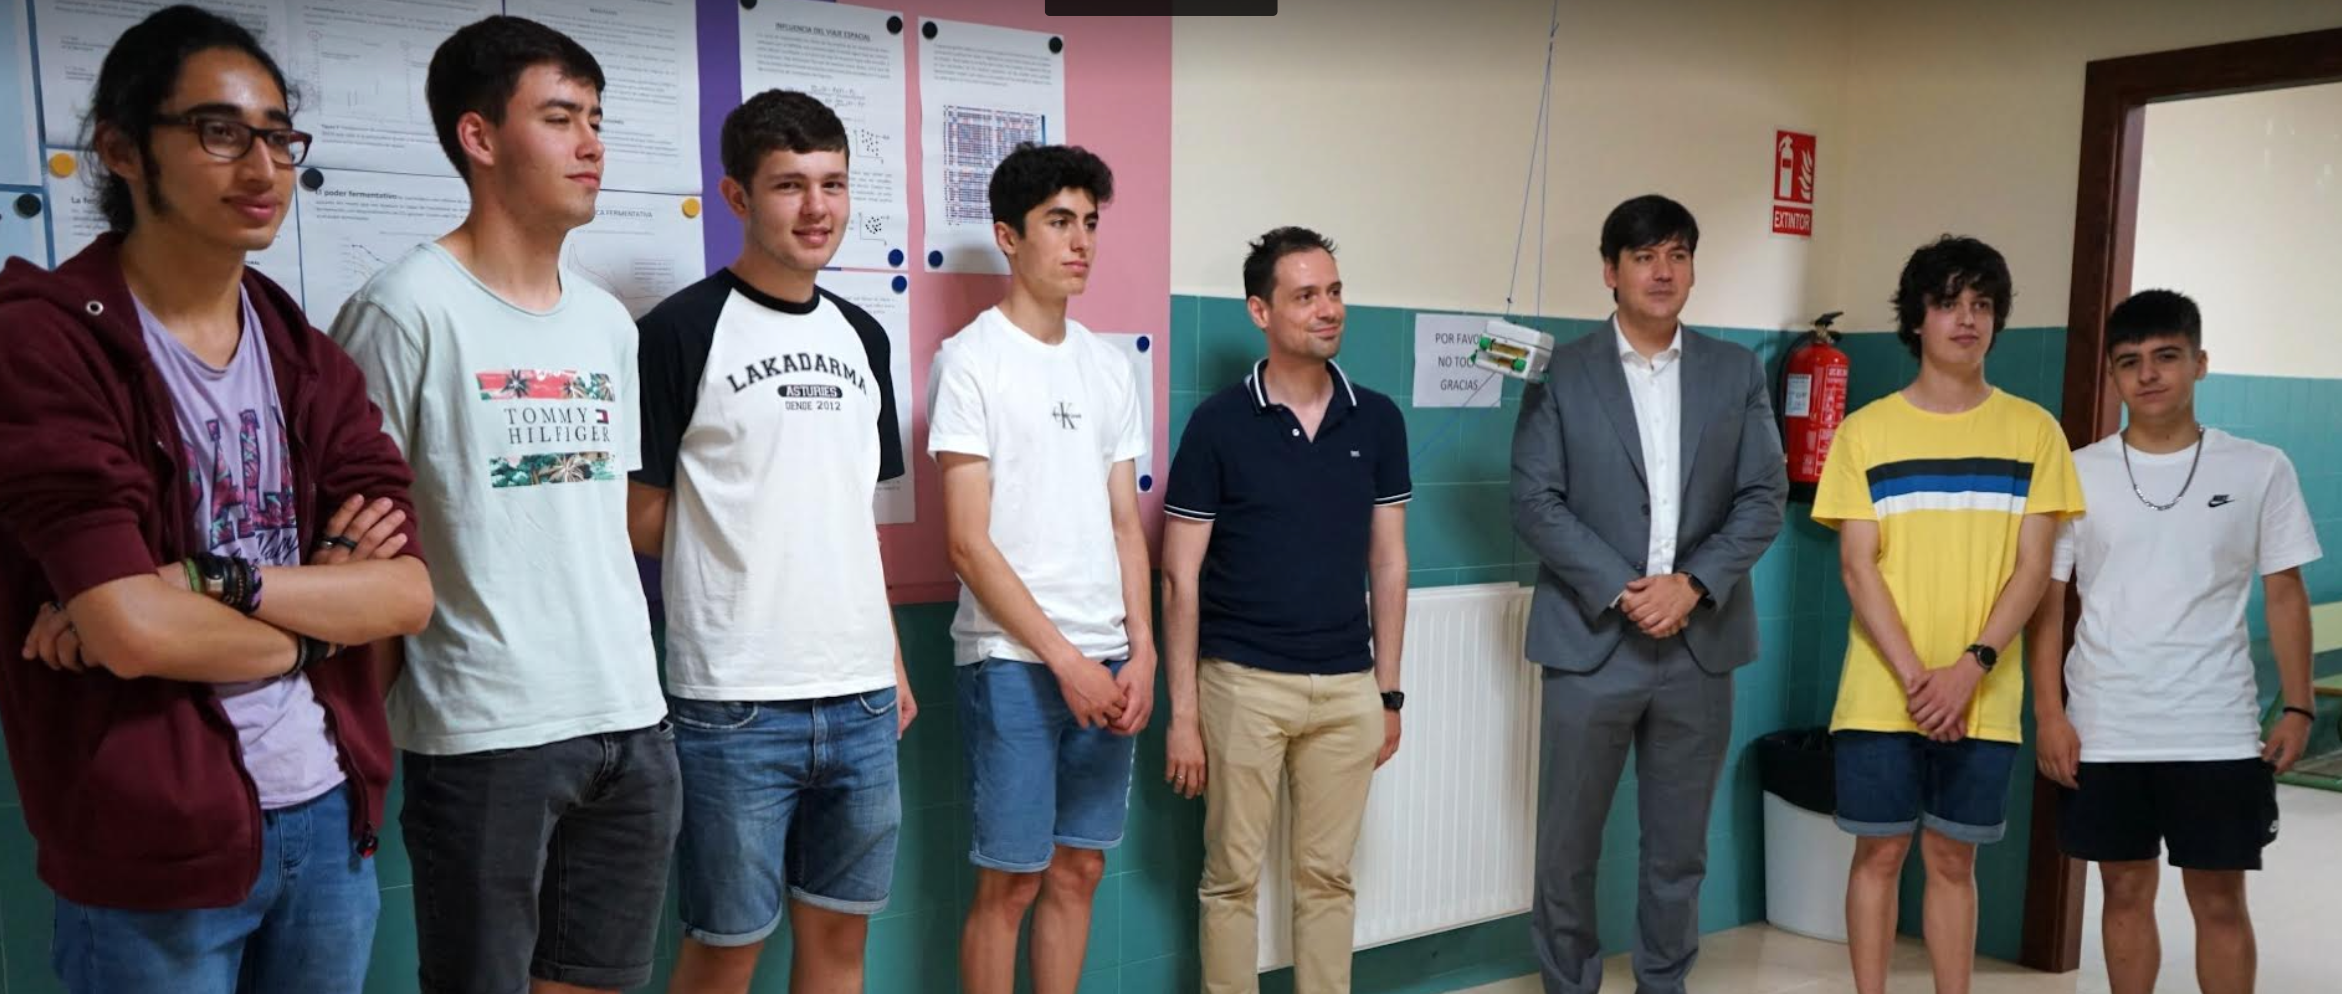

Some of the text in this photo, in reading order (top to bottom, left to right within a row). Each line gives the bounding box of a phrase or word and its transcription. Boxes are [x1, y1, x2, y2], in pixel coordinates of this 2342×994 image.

[775, 22, 812, 34] INFLUENCIA
[814, 26, 825, 35] DEL
[844, 31, 871, 42] ESPACIAL
[324, 189, 346, 197] poder
[348, 191, 397, 200] fermentativo
[1774, 210, 1811, 230] EXTINTOR
[1435, 332, 1454, 344] POR
[1438, 356, 1452, 367] NO
[1440, 379, 1478, 391] GRACIAS
[786, 386, 837, 398] ASTURIES
[816, 401, 841, 411] 2012
[504, 407, 588, 425] TOMMY
[508, 425, 611, 445] HILFIGER
